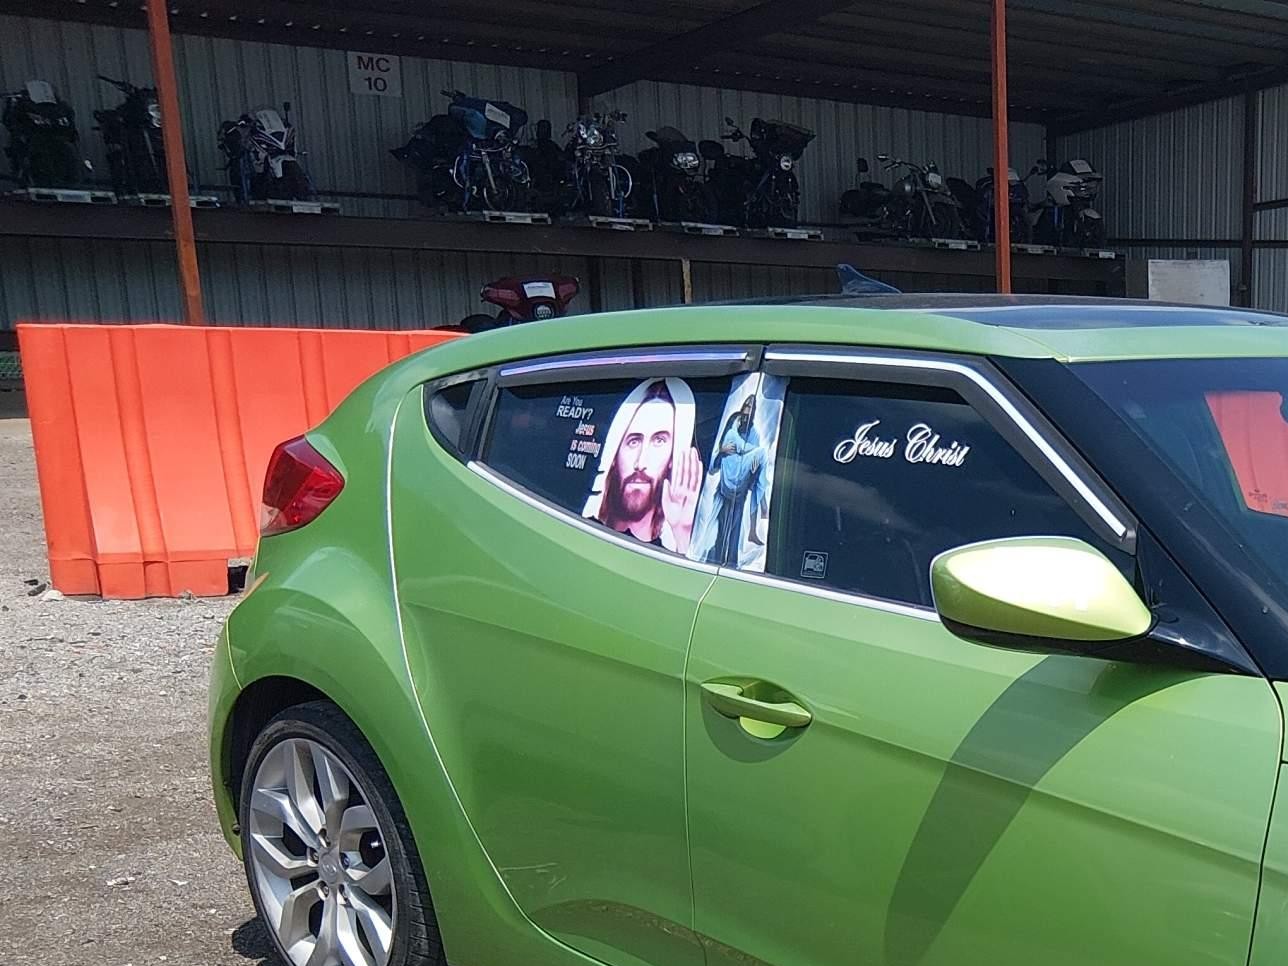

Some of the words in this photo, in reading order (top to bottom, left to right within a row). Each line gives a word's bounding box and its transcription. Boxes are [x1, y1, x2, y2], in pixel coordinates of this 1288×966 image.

[357, 55, 390, 72] MC
[364, 76, 387, 91] 10
[561, 396, 571, 405] Are
[573, 397, 583, 406] You
[556, 406, 593, 420] READY?
[575, 420, 595, 435] Jesus
[578, 438, 601, 457] coming
[833, 420, 898, 463] Jesus
[904, 423, 970, 467] Christ
[566, 453, 587, 469] SOON
